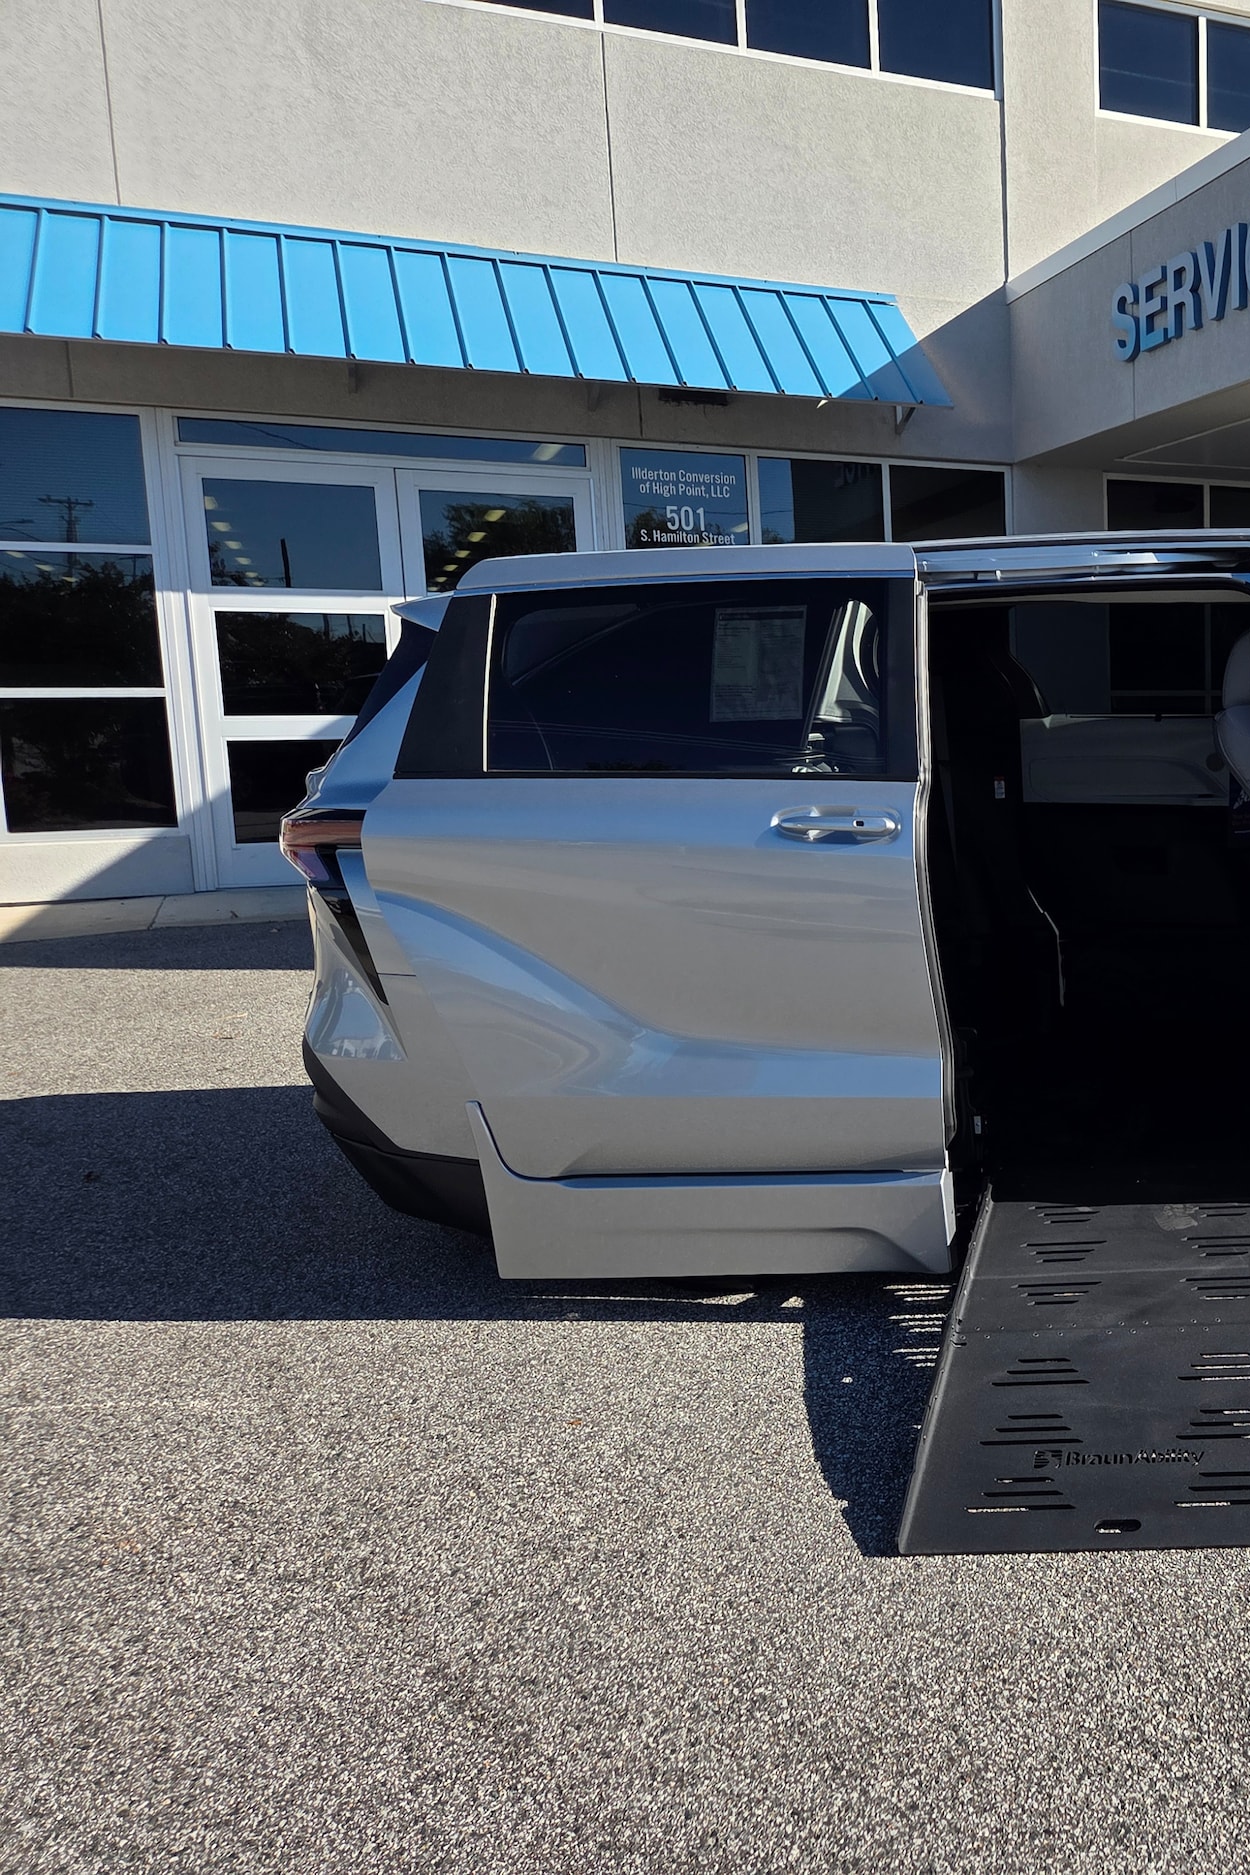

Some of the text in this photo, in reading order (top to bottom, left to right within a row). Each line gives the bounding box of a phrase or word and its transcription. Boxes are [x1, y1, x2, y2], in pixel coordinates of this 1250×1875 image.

[678, 469, 736, 485] Conversion
[639, 482, 730, 499] of High Point, LLC
[666, 505, 705, 531] 501
[640, 529, 735, 545] S. Hamilton Street
[1066, 1449, 1204, 1466] BraunAbility
